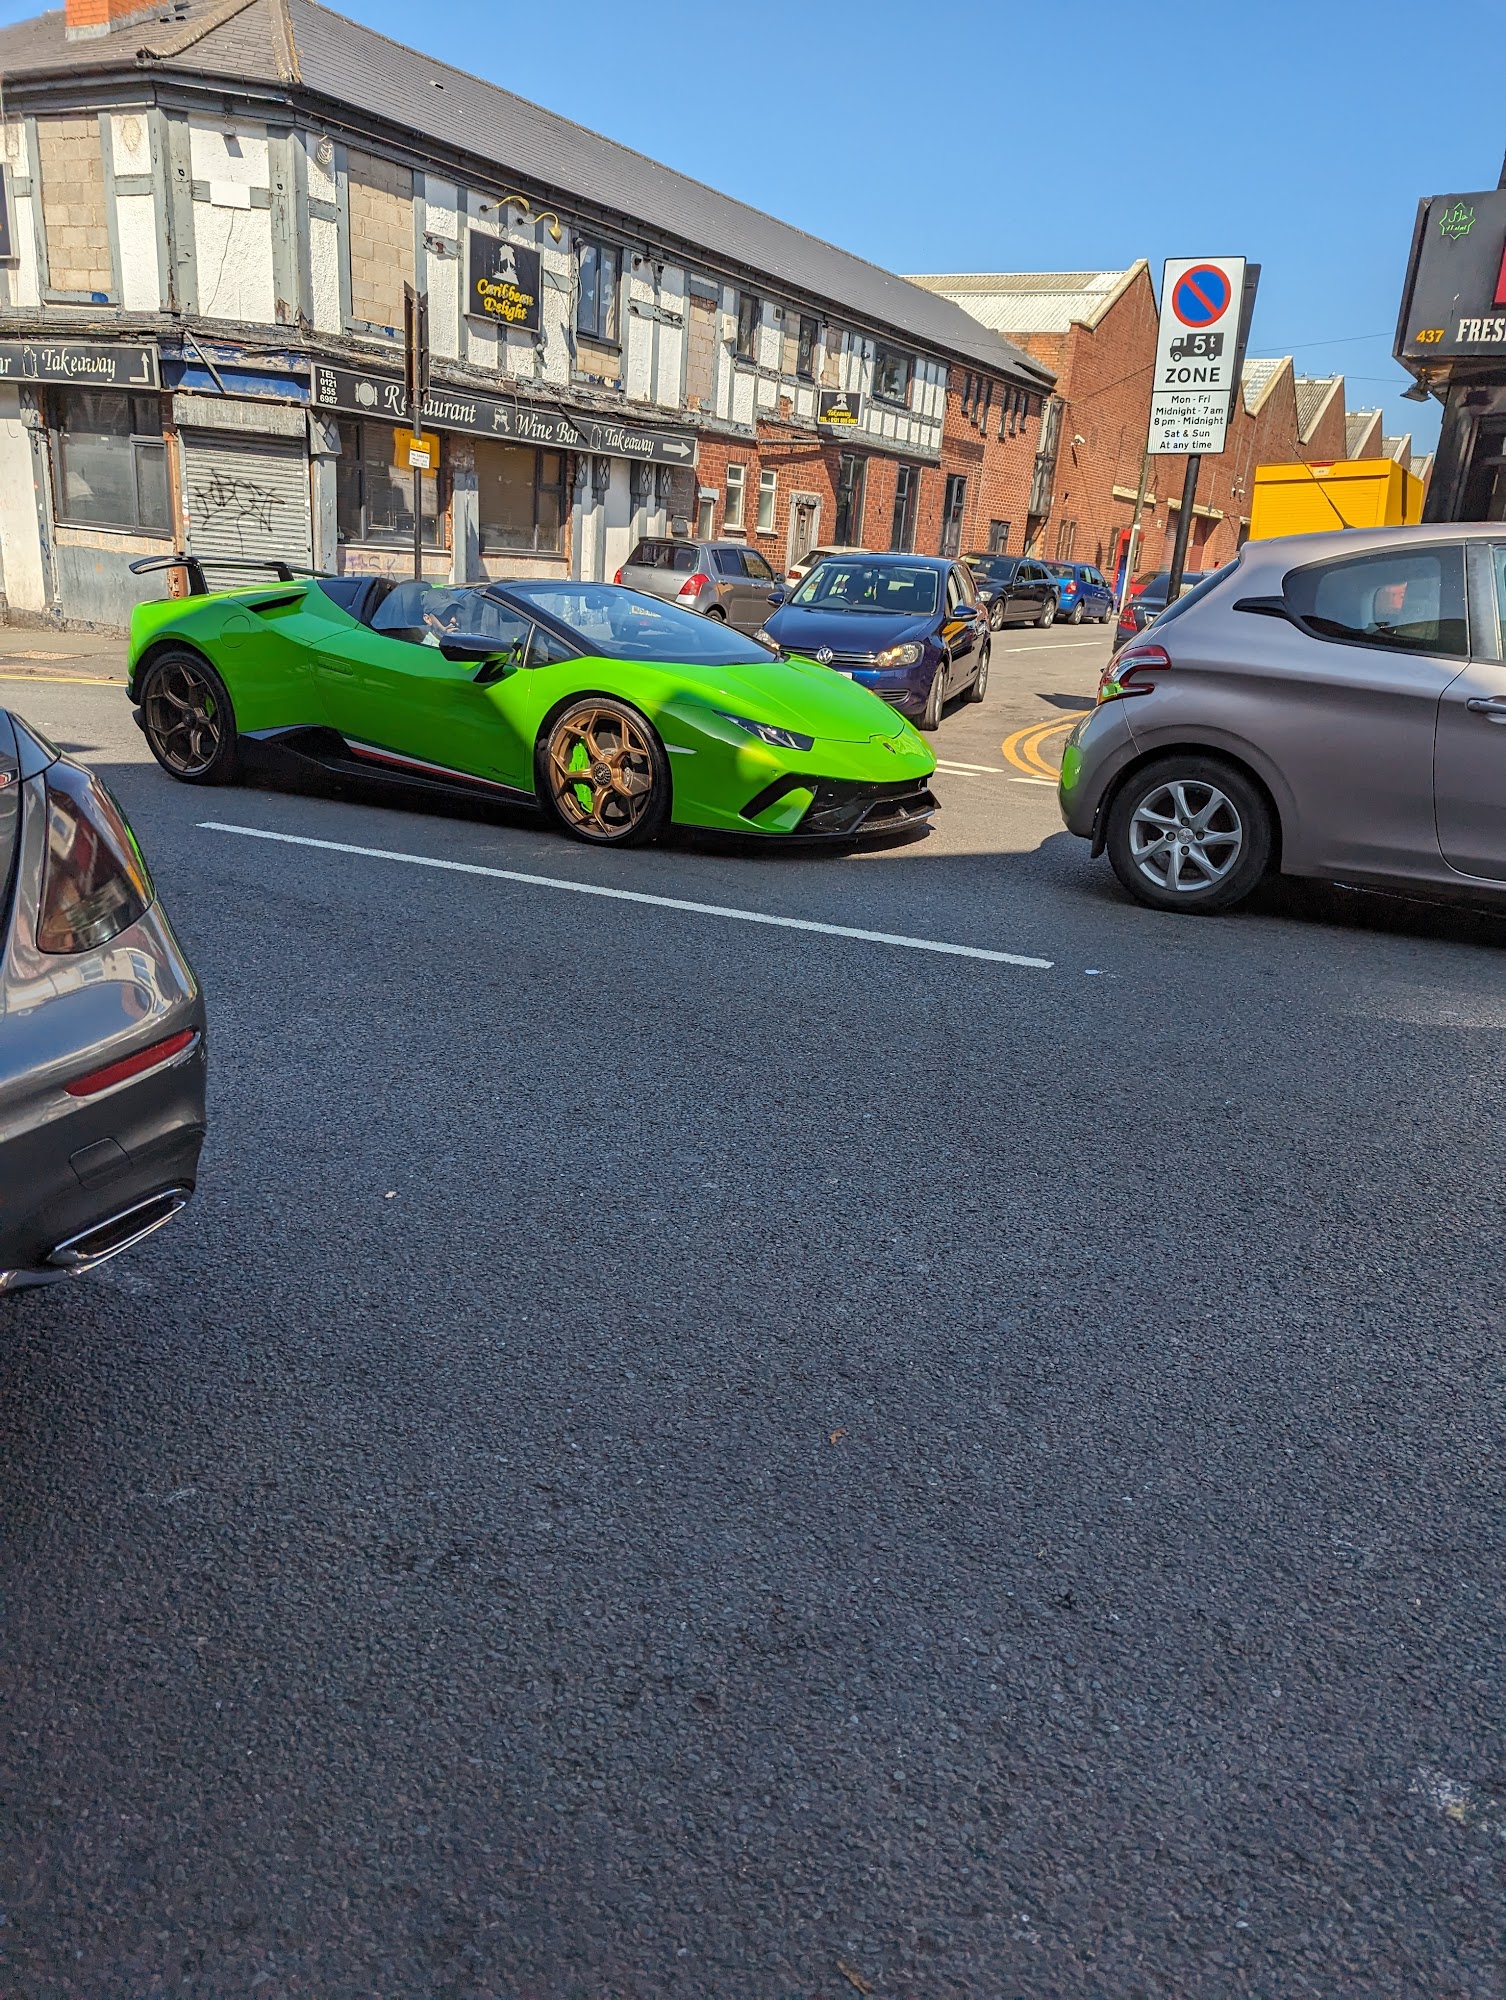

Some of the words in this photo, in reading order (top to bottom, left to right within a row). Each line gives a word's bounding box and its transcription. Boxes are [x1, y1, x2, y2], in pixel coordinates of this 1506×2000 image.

[477, 278, 534, 306] Caribbean
[484, 297, 528, 321] Delight
[1416, 328, 1445, 343] 437
[1455, 318, 1506, 343] FRES
[42, 348, 116, 382] Takeaway
[319, 368, 336, 380] TEL
[1165, 367, 1220, 383] ZONE
[319, 378, 337, 388] 0121
[321, 386, 336, 396] 555
[319, 394, 338, 405] 6987
[1171, 395, 1191, 404] Mon
[1198, 395, 1211, 403] Fri
[1156, 407, 1196, 416] Midnight
[384, 384, 477, 424] Reaurant
[516, 413, 553, 440] Wine
[605, 428, 655, 458] Takeaway
[1183, 417, 1224, 426] Midnight
[1164, 430, 1180, 438] Sat
[1192, 429, 1210, 437] Sun
[1159, 441, 1170, 449] At
[1173, 442, 1189, 450] any
[1192, 440, 1212, 449] time
